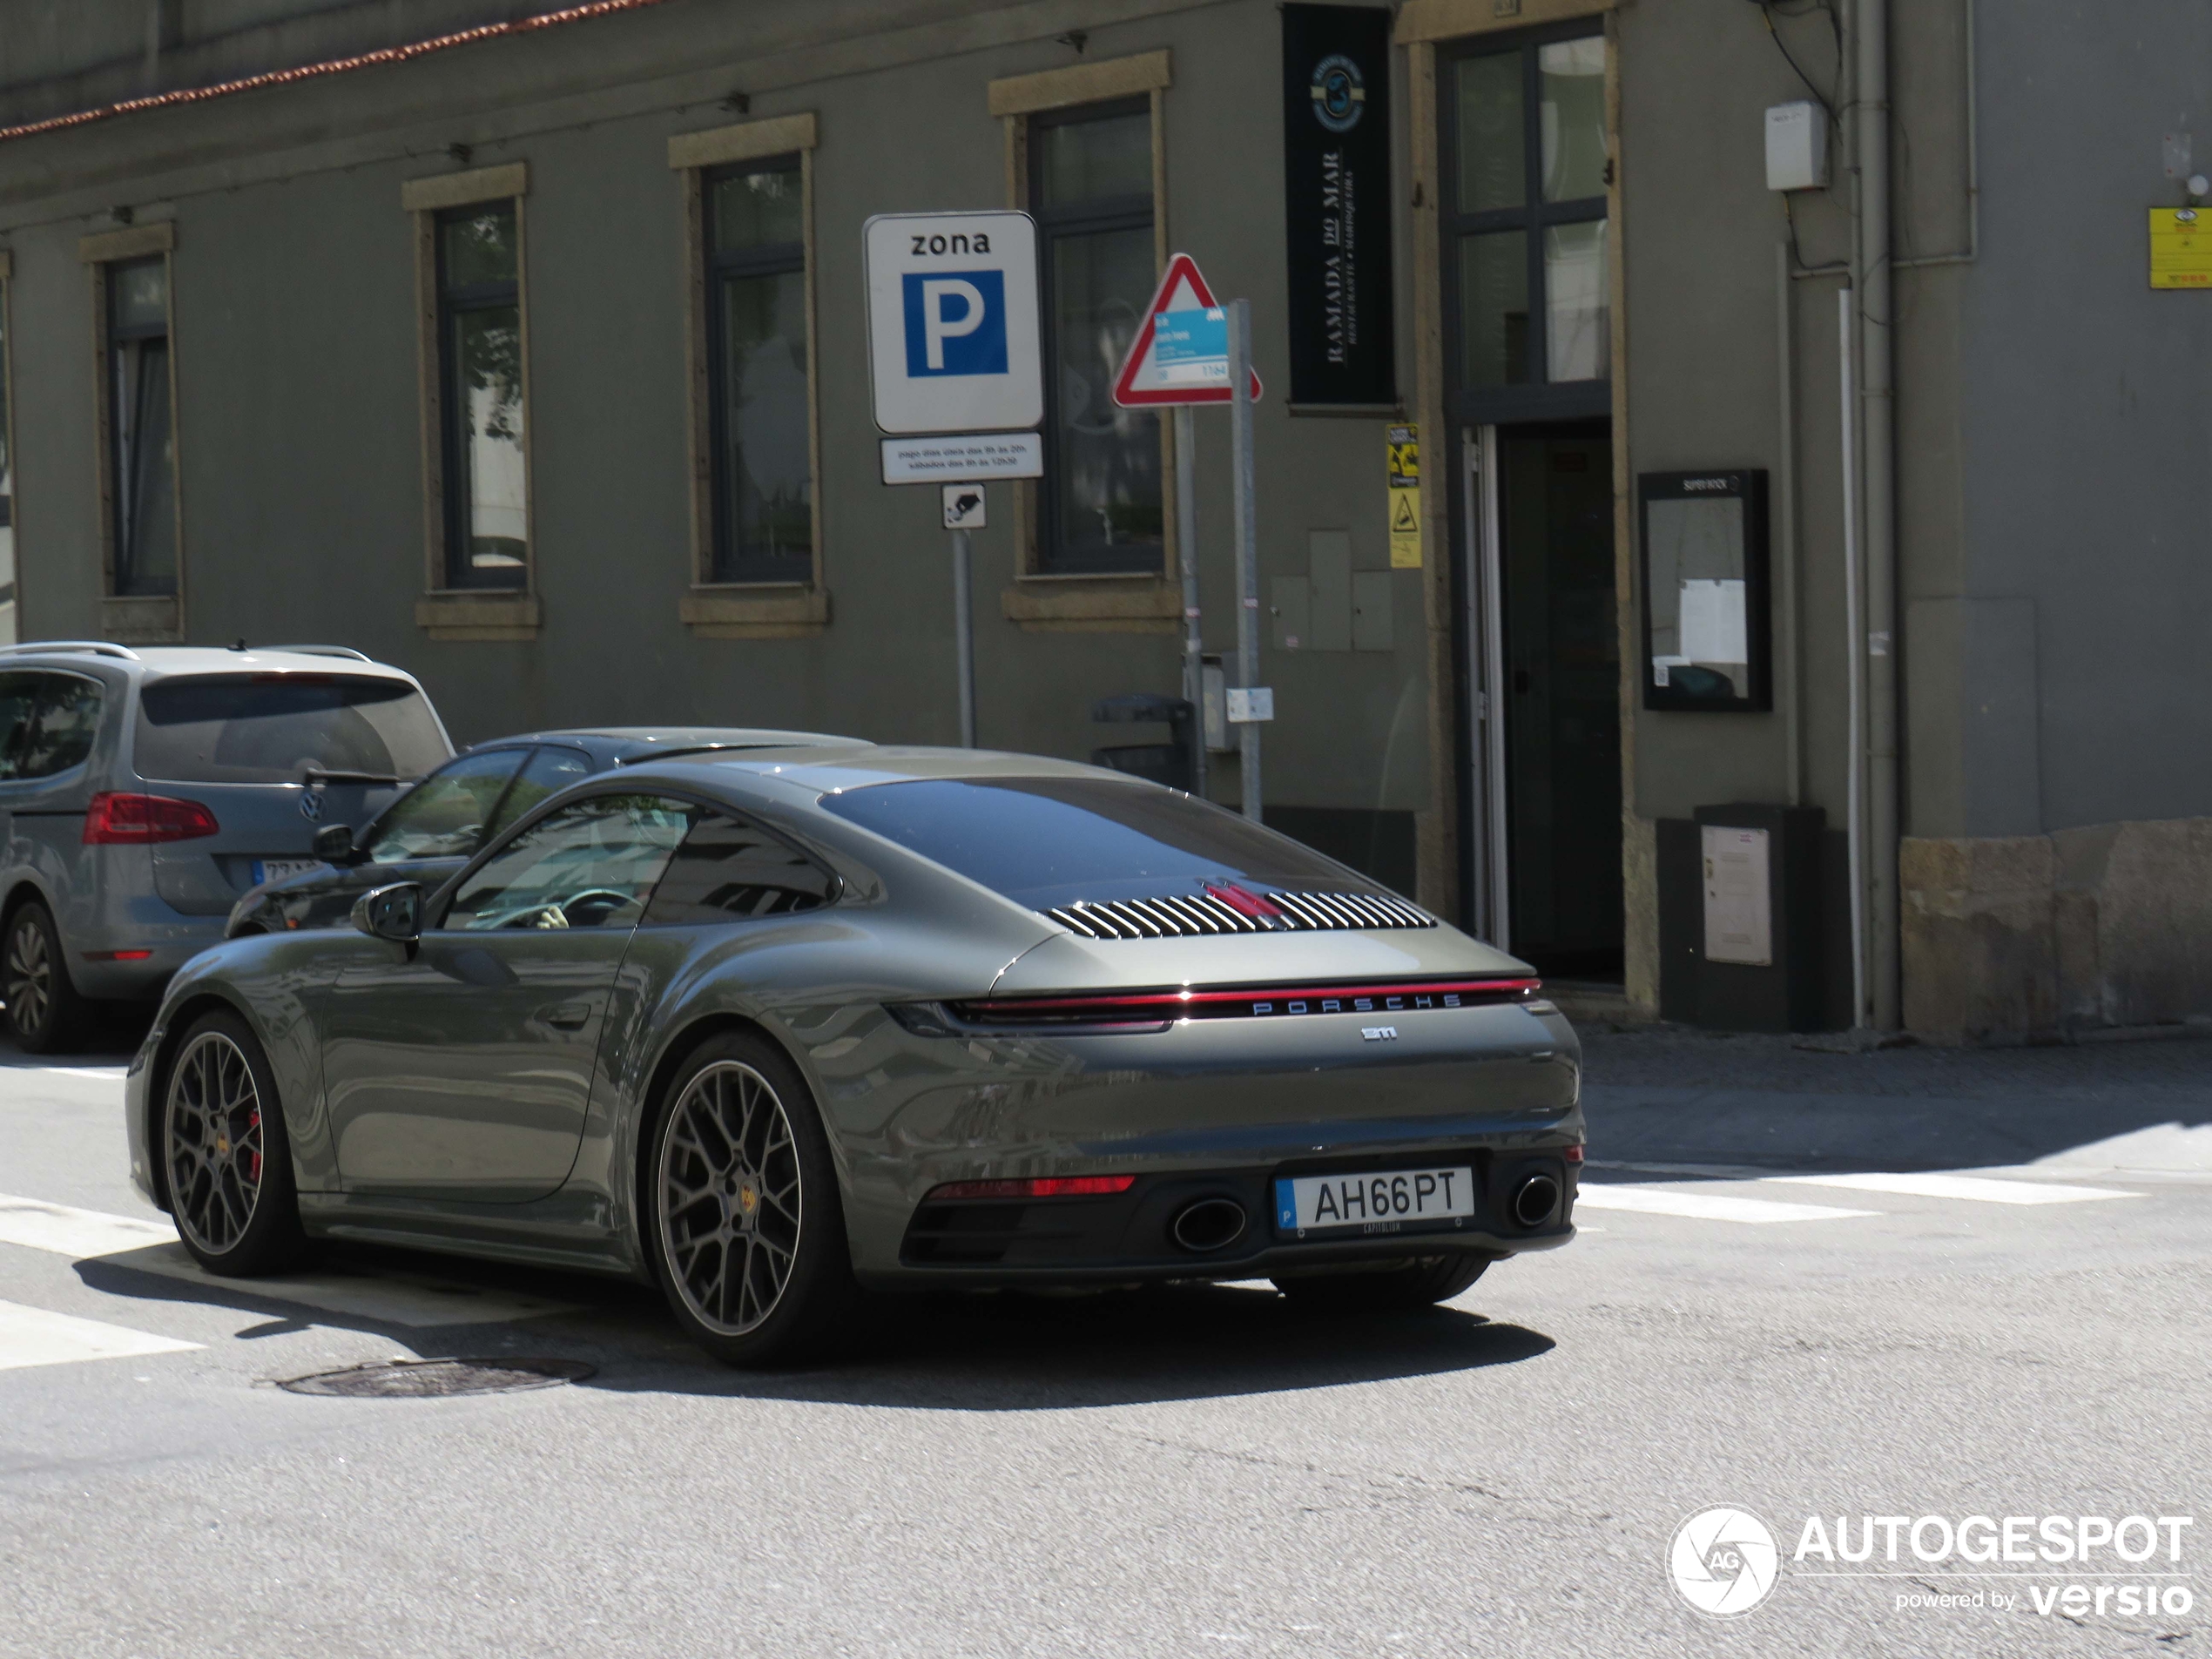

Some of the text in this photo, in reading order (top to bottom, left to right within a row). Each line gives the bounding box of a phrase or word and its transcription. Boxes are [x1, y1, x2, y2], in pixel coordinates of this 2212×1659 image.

[911, 233, 991, 256] zona
[1323, 152, 1343, 362] RAMADA DO MAR
[922, 279, 985, 370] P
[1253, 994, 1461, 1015] PORSCHE
[1315, 1172, 1455, 1223] AH66PT
